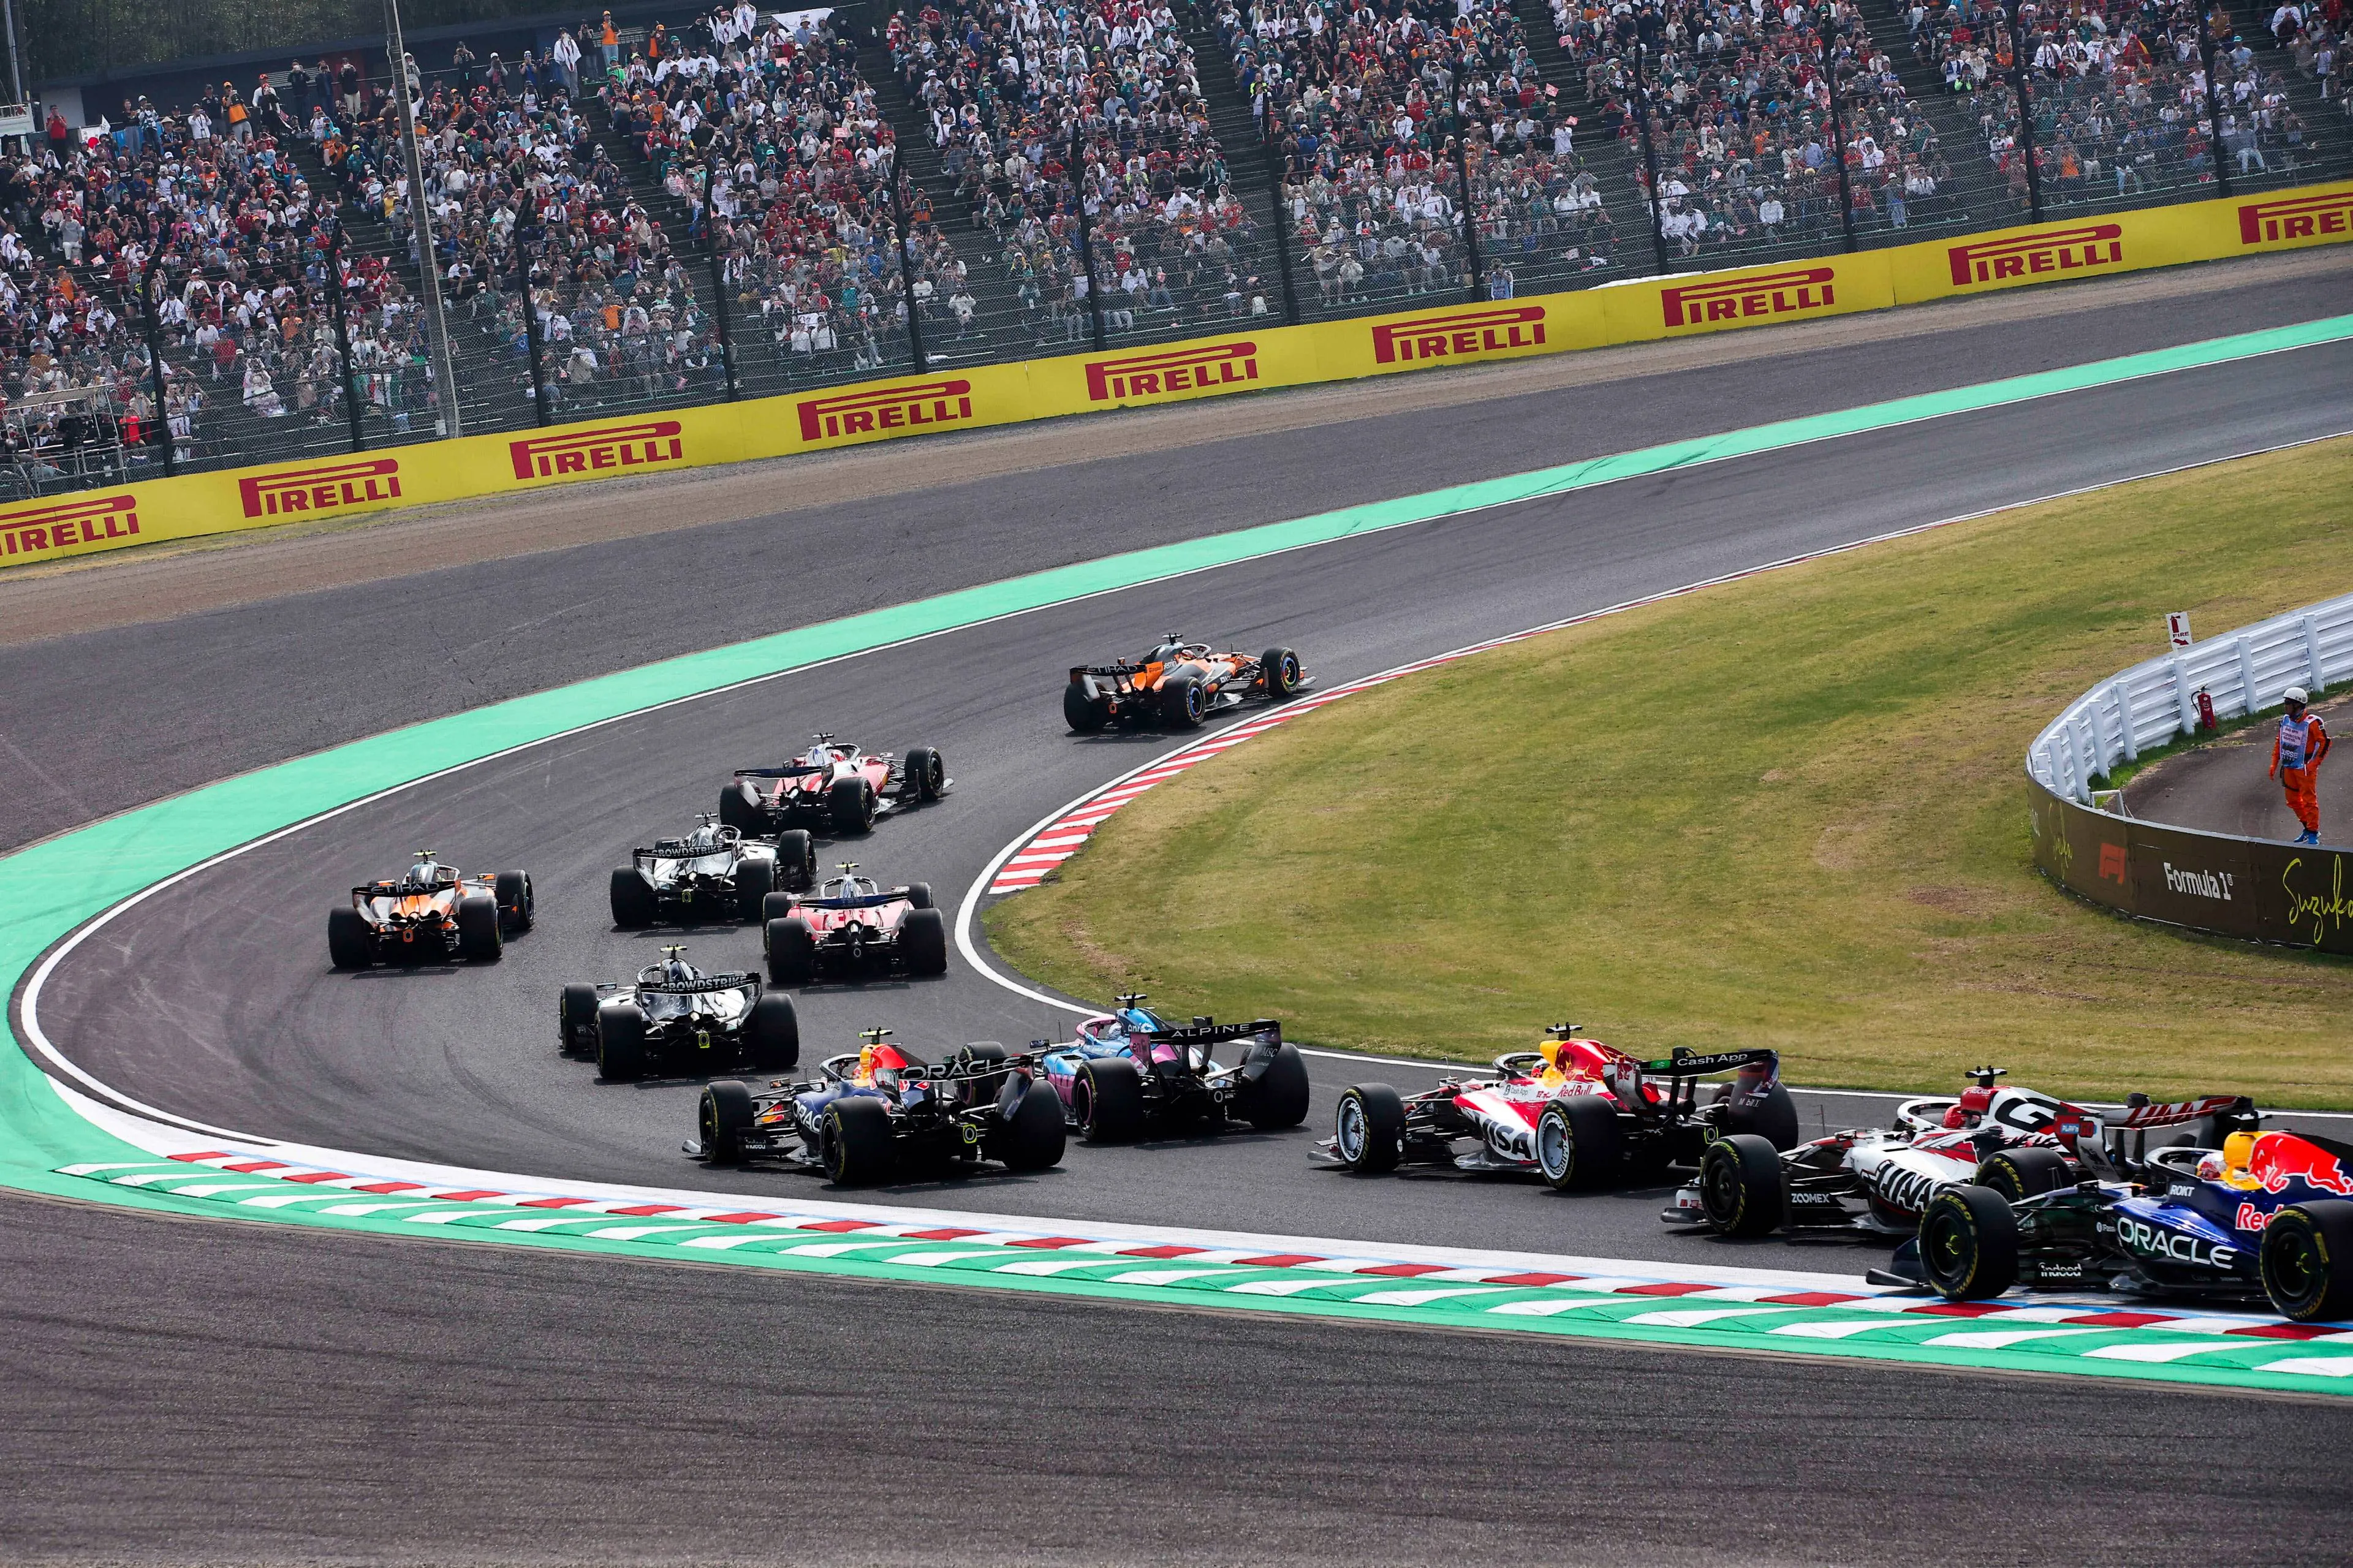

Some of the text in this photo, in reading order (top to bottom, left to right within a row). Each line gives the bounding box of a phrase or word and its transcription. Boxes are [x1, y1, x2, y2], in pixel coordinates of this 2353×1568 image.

[2238, 192, 2353, 244] PIRE
[1948, 224, 2122, 285] PIRELLI
[1661, 267, 1835, 327] PIRELLI
[1372, 306, 1545, 363] PIRELLI
[1085, 342, 1258, 401] PIRELLI
[797, 380, 972, 441] PIRELLI
[509, 420, 682, 479] PIRELLI
[238, 458, 401, 517] PIRELLI
[651, 844, 724, 857] CROWDSTRIKE
[371, 882, 439, 894] ETIHAD
[2164, 862, 2221, 900] Formula
[660, 977, 746, 992] CROWDSTRIKE
[1171, 1024, 1250, 1037] ALPINE
[901, 1056, 1021, 1080] ORACLE
[1677, 1053, 1748, 1066] Cash App
[1557, 1085, 1593, 1097] Red Bull
[2000, 1162, 2023, 1194] ZERO
[2170, 1184, 2194, 1197] ROKT
[1791, 1192, 1831, 1204] ZOOMEX
[2117, 1217, 2238, 1270] ORACLE
